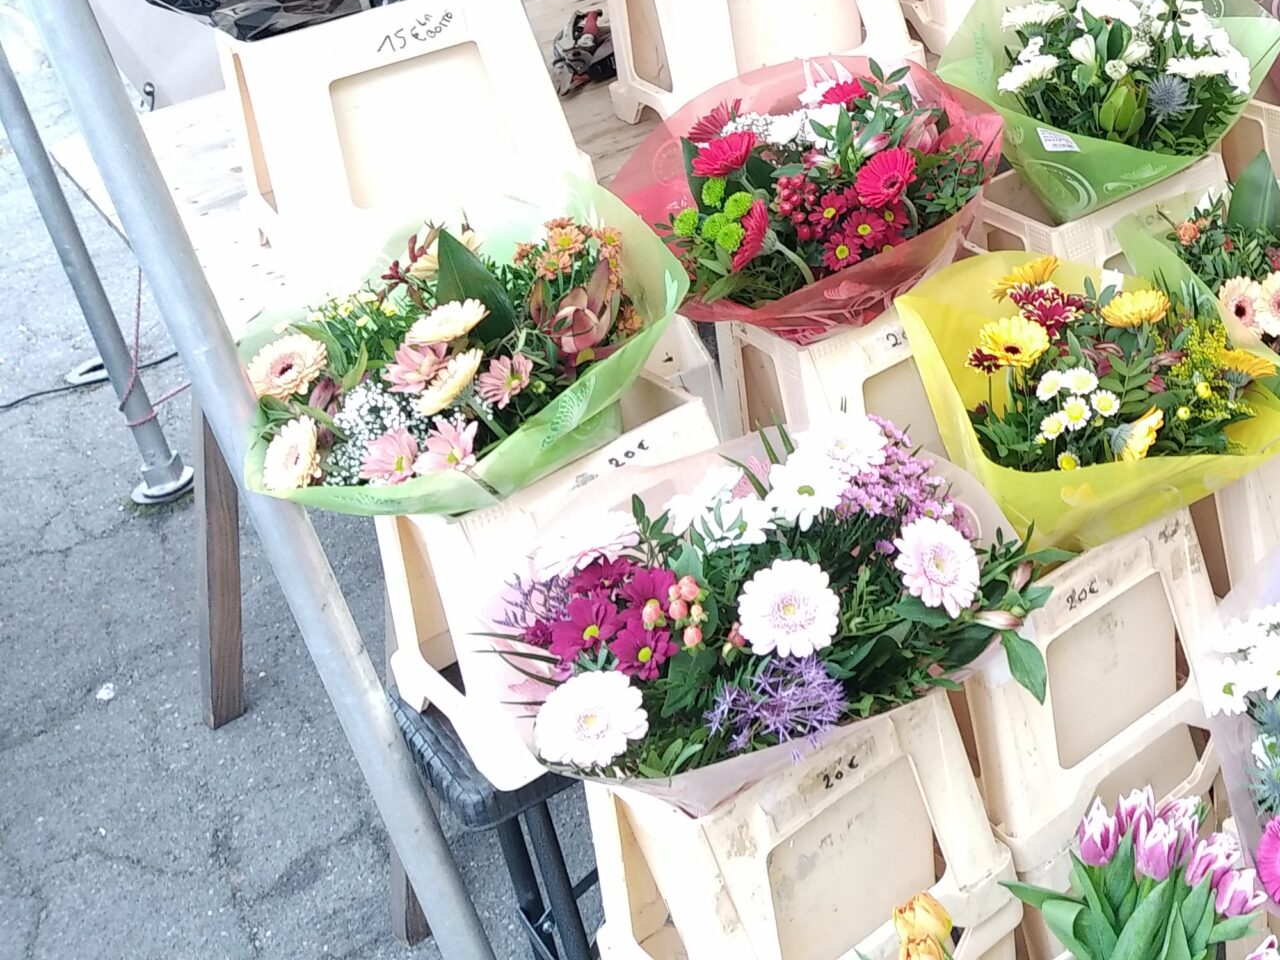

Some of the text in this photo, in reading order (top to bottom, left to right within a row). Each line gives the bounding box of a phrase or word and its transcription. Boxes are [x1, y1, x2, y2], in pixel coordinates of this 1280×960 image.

[608, 439, 649, 468] 20€
[1066, 577, 1099, 611] 20€
[823, 755, 859, 789] 20€
